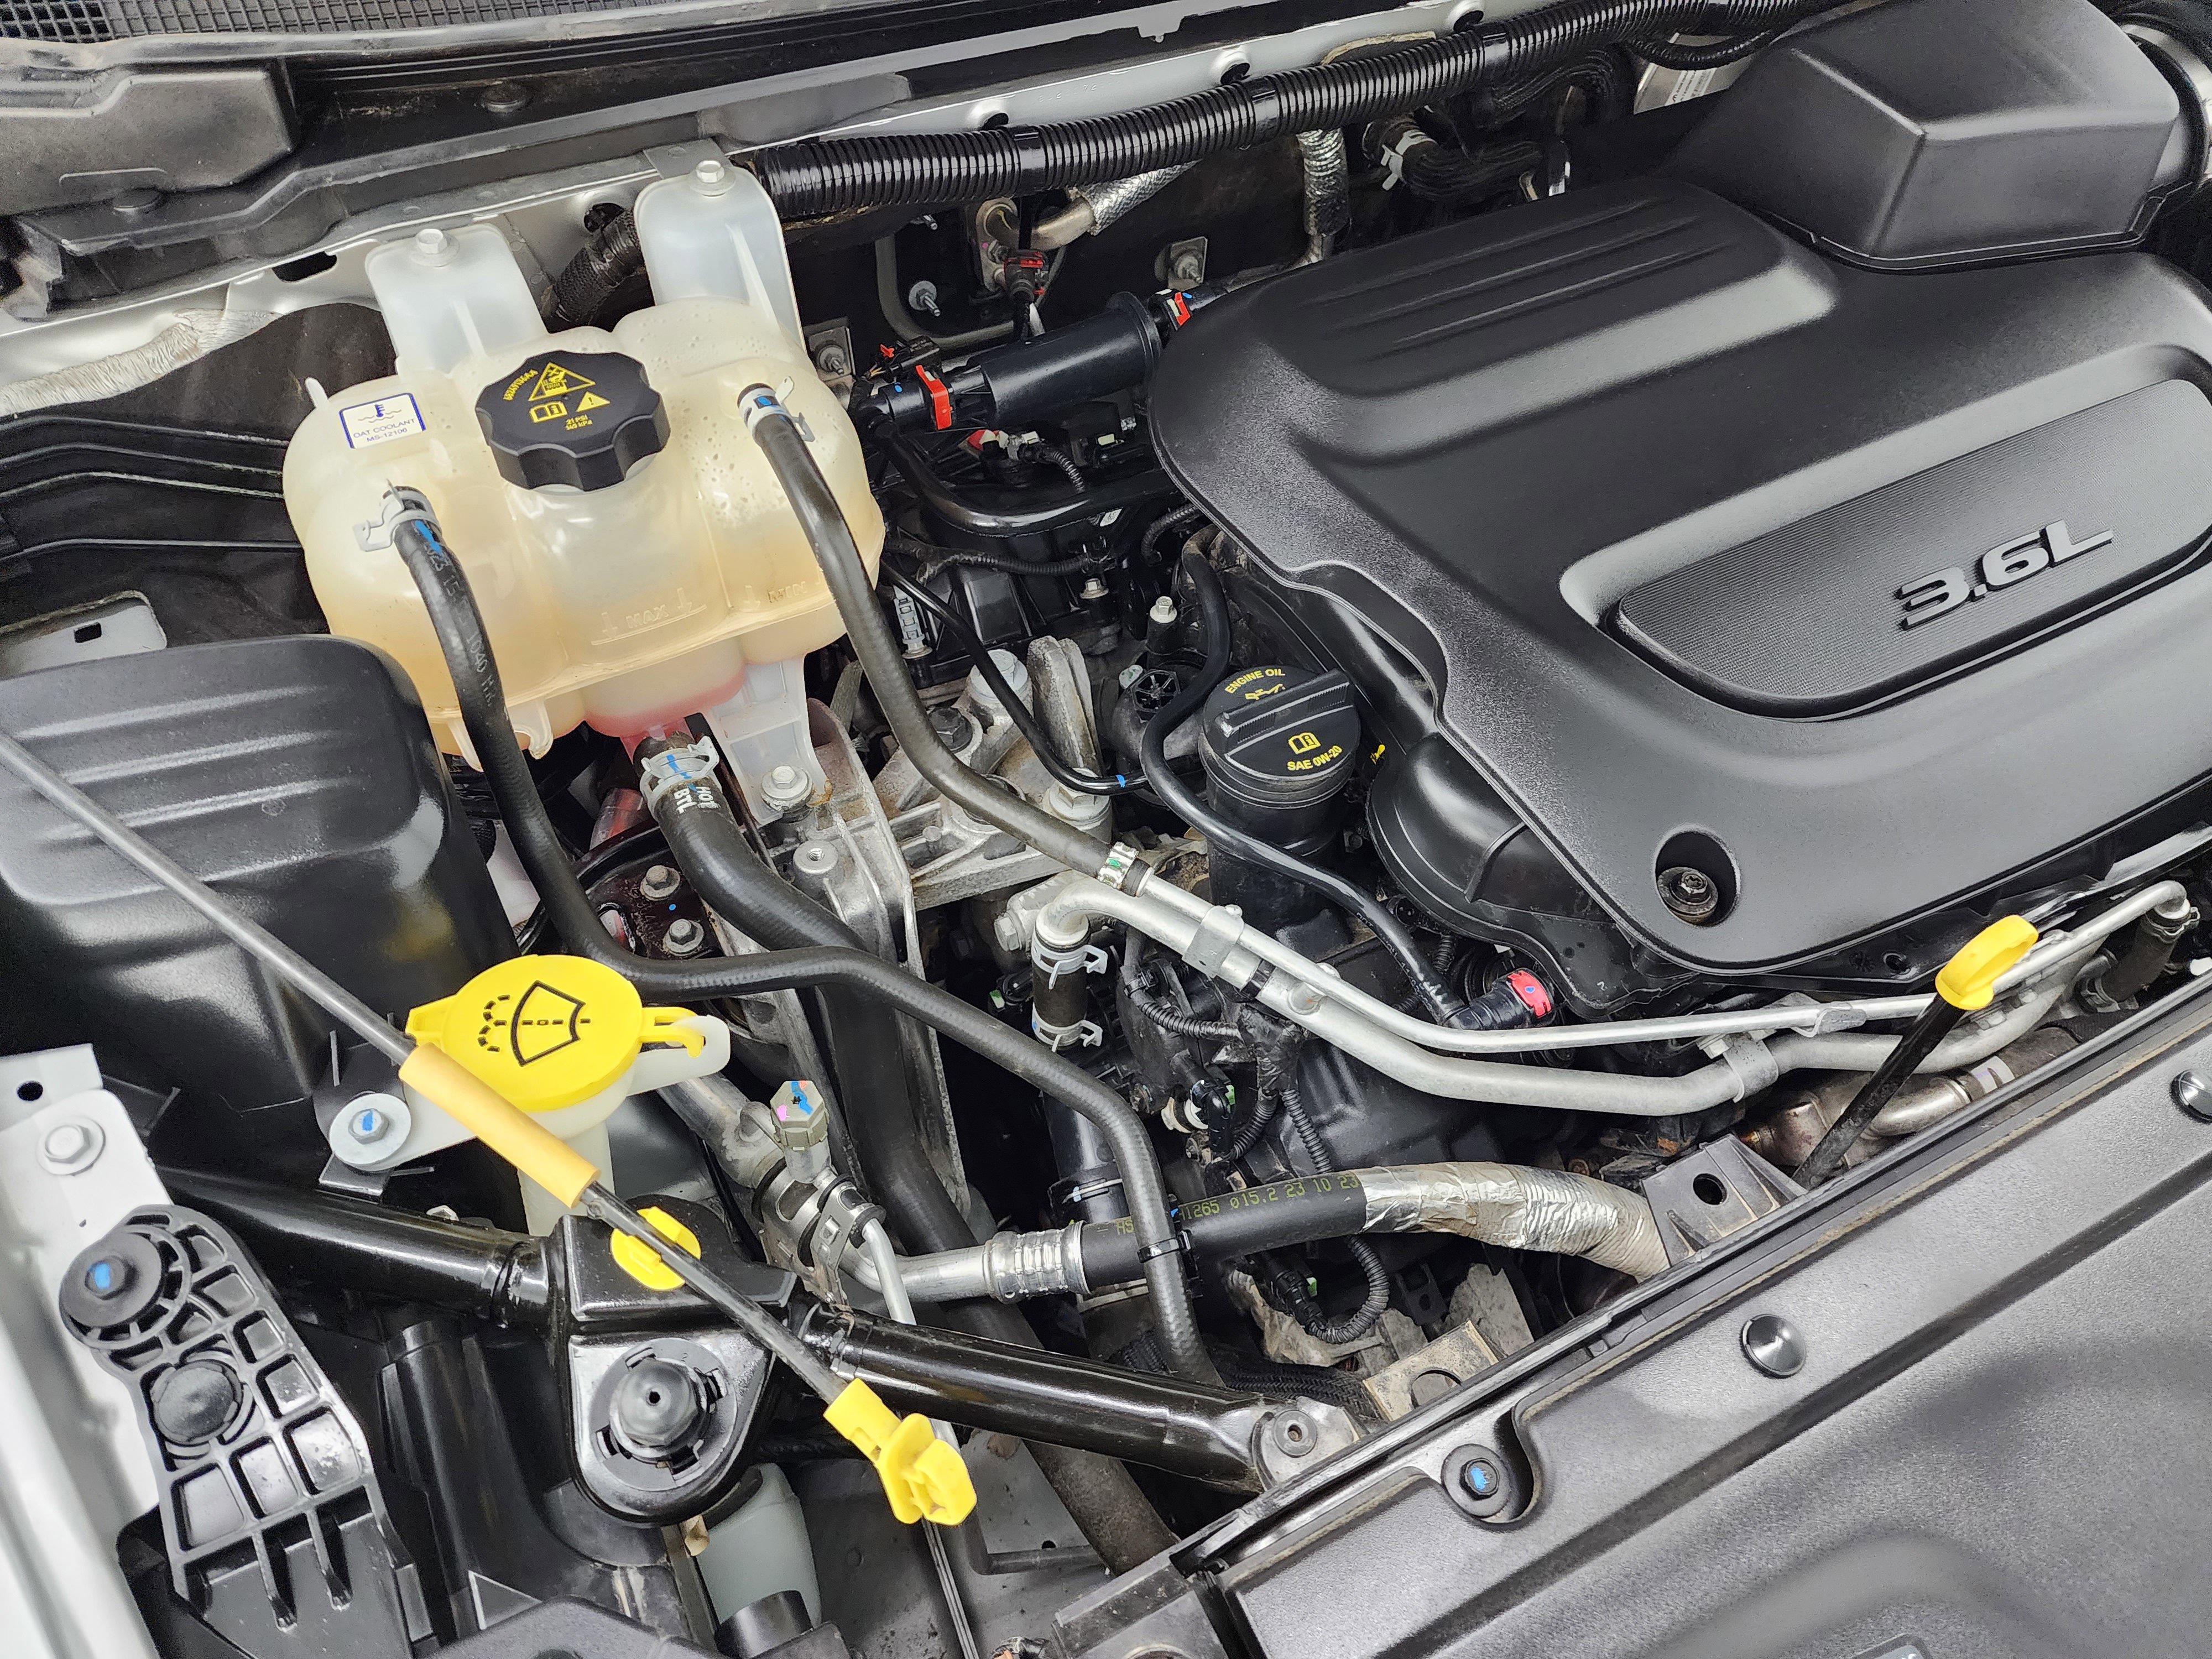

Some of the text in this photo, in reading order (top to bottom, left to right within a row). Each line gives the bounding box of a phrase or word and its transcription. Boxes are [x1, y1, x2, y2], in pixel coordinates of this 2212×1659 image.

[353, 418, 415, 438] OAT COOLANT
[1896, 519, 2114, 629] 3.6L
[767, 581, 808, 604] MIN
[626, 604, 669, 629] MAX
[1224, 669, 1286, 694] ENGINE OIL
[1287, 745, 1343, 771] SAE 0W-20
[674, 788, 697, 814] BTL
[1284, 1181, 1306, 1198] 23
[1312, 1177, 1332, 1193] 10
[1337, 1175, 1360, 1190] 23
